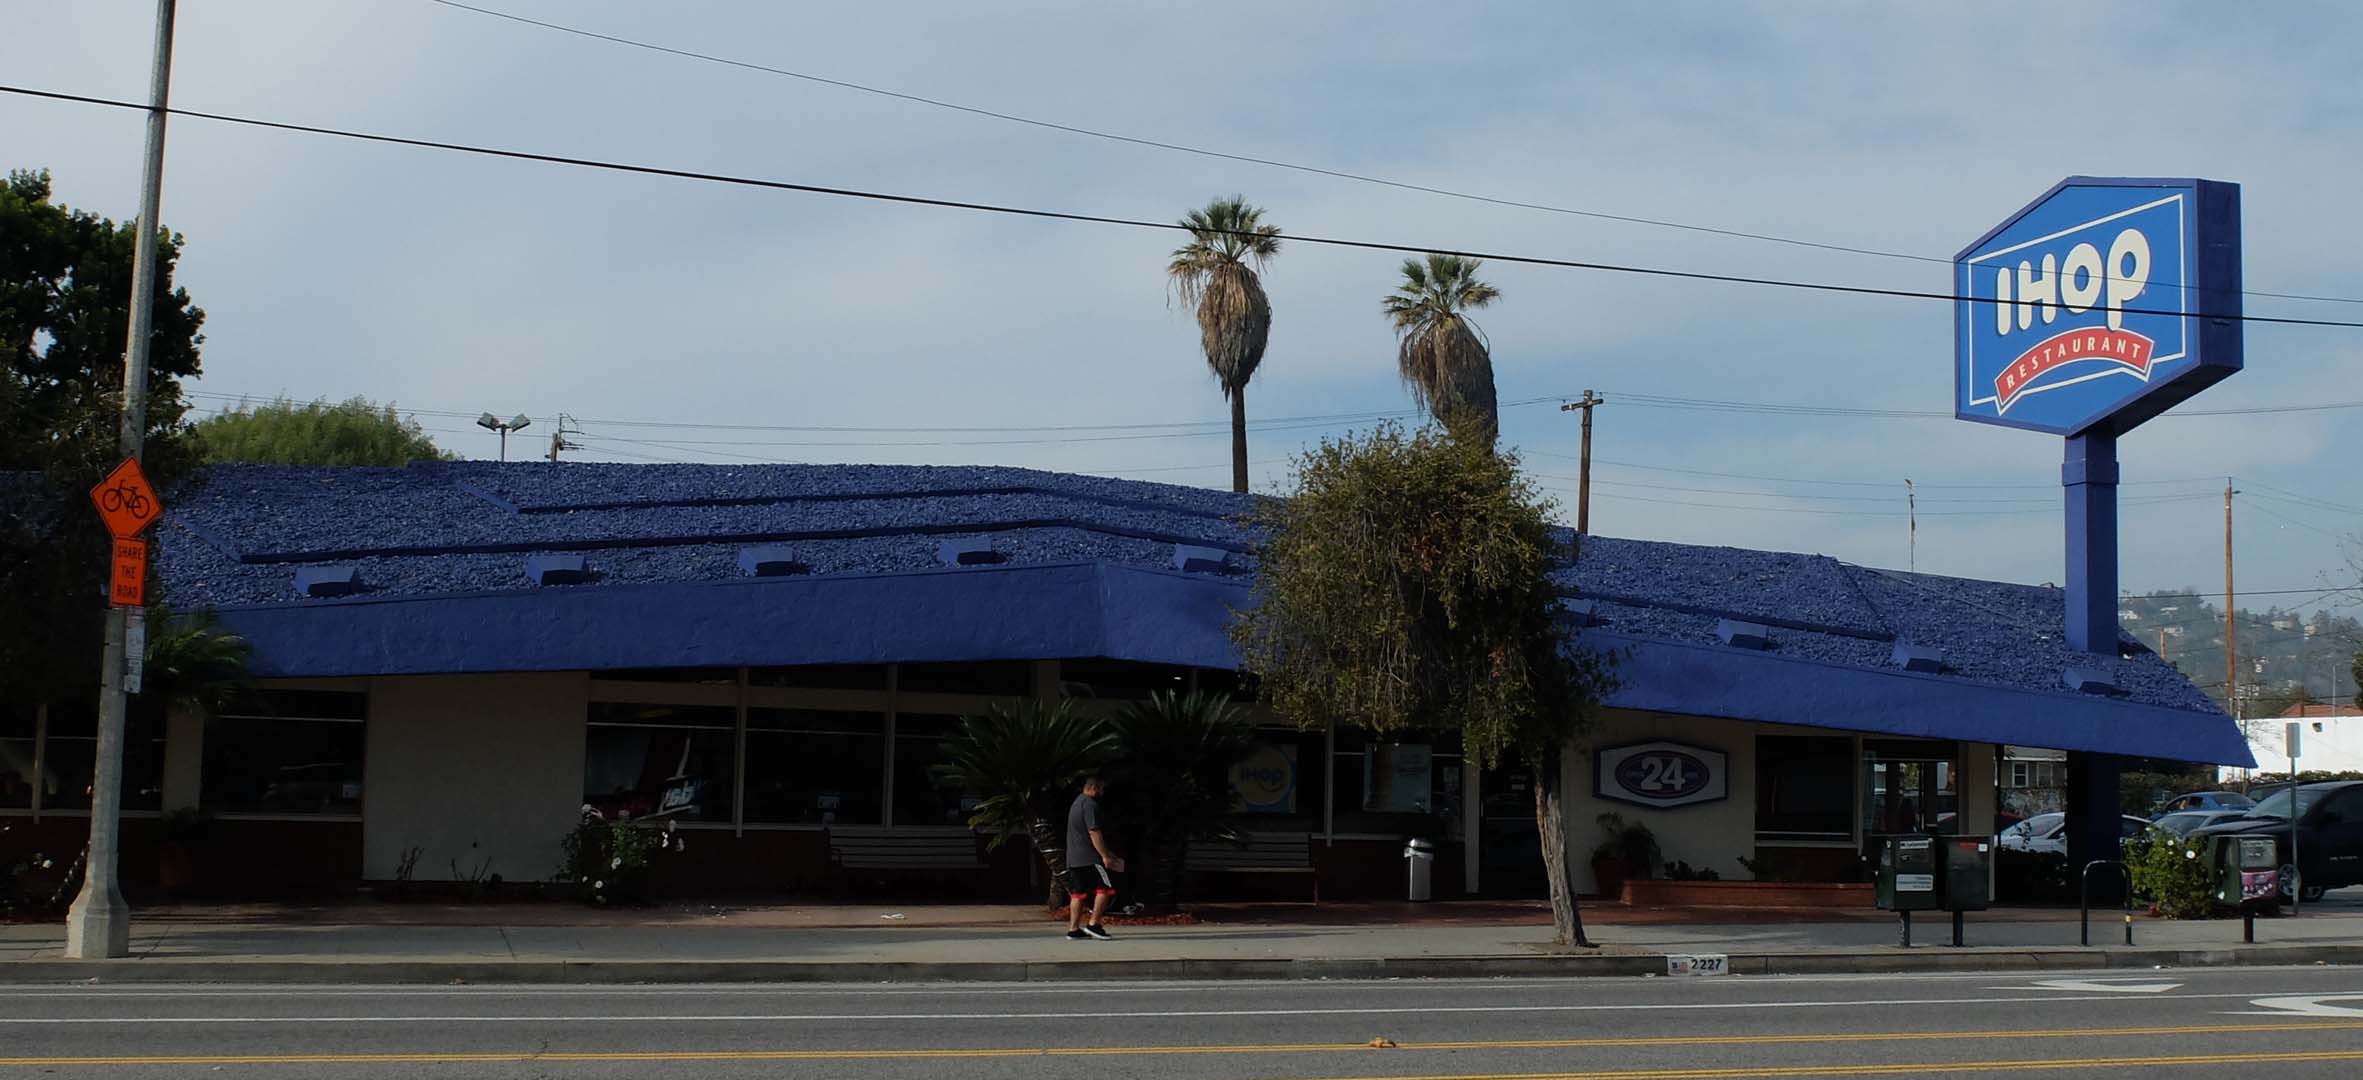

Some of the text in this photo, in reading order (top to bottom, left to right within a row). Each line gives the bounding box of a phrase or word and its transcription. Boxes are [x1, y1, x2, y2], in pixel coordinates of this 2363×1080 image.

[1996, 227, 2151, 336] IHOP
[2005, 337, 2142, 390] RESTAURANT
[117, 546, 143, 561] SHARE
[120, 565, 137, 579] THE
[116, 584, 138, 599] ROAD
[1640, 757, 1686, 791] 24
[1691, 958, 1722, 970] 2227
